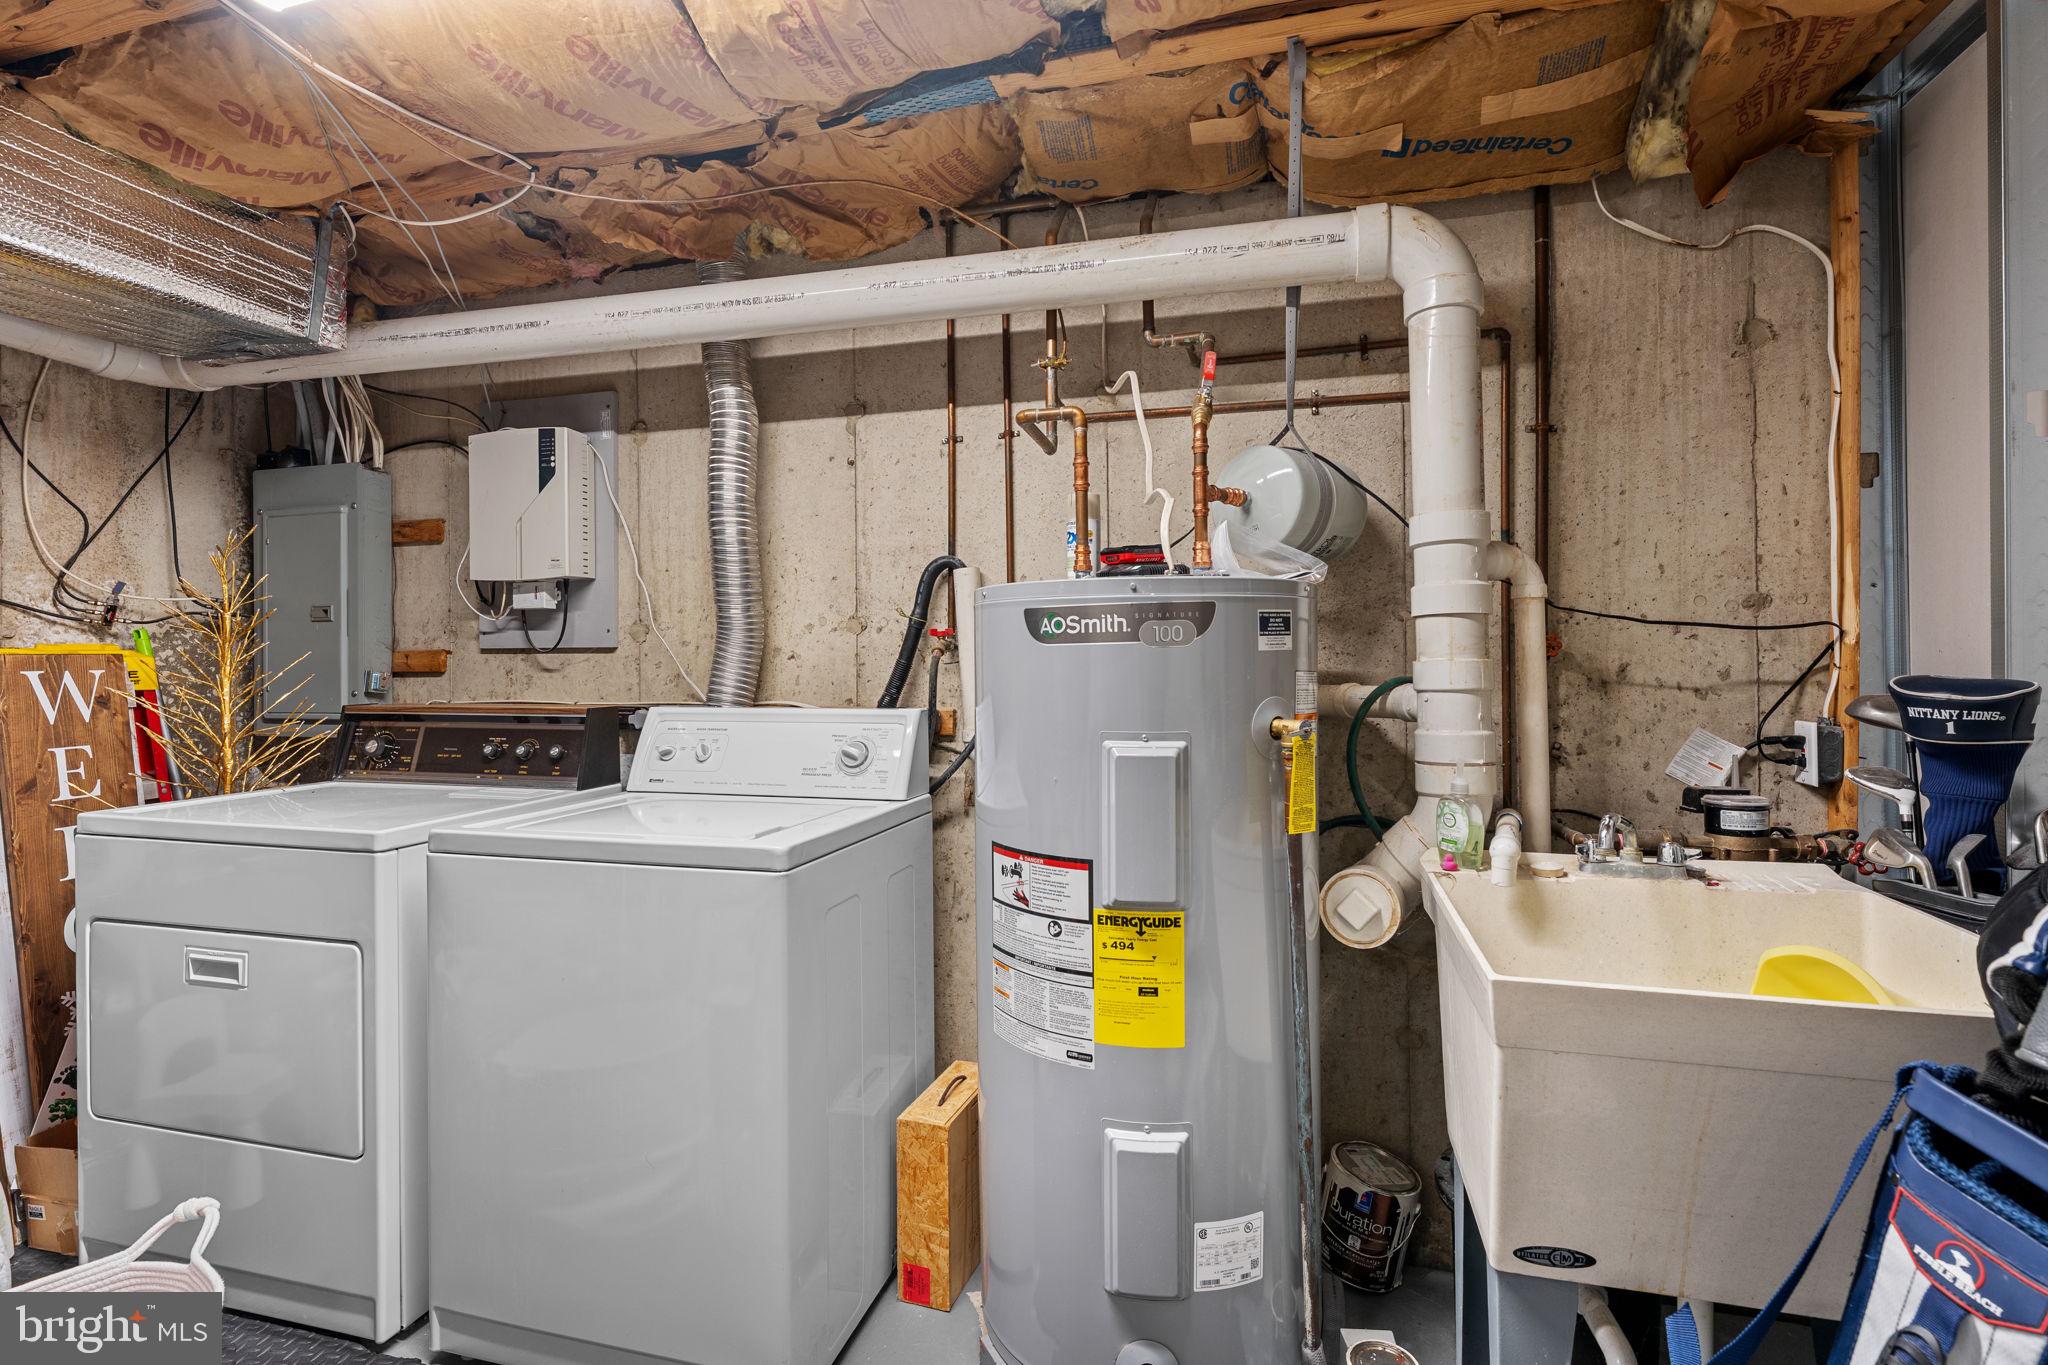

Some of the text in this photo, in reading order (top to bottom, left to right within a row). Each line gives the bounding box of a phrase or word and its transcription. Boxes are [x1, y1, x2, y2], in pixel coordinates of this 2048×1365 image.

[565, 34, 730, 128] Manville
[467, 42, 648, 141] Manville
[217, 99, 407, 165] Manville
[139, 122, 331, 186] Manville
[1412, 137, 1573, 157] CertainTeed
[1135, 610, 1201, 619] SIGNATURE
[1152, 624, 1183, 643] 100
[1907, 706, 1960, 720] NITTANY
[1945, 721, 1957, 735] 1
[1024, 856, 1044, 864] DANGER
[1097, 914, 1182, 930] ENERGYGUIDE
[1110, 941, 1135, 951] 494
[1330, 1200, 1393, 1236] Duration
